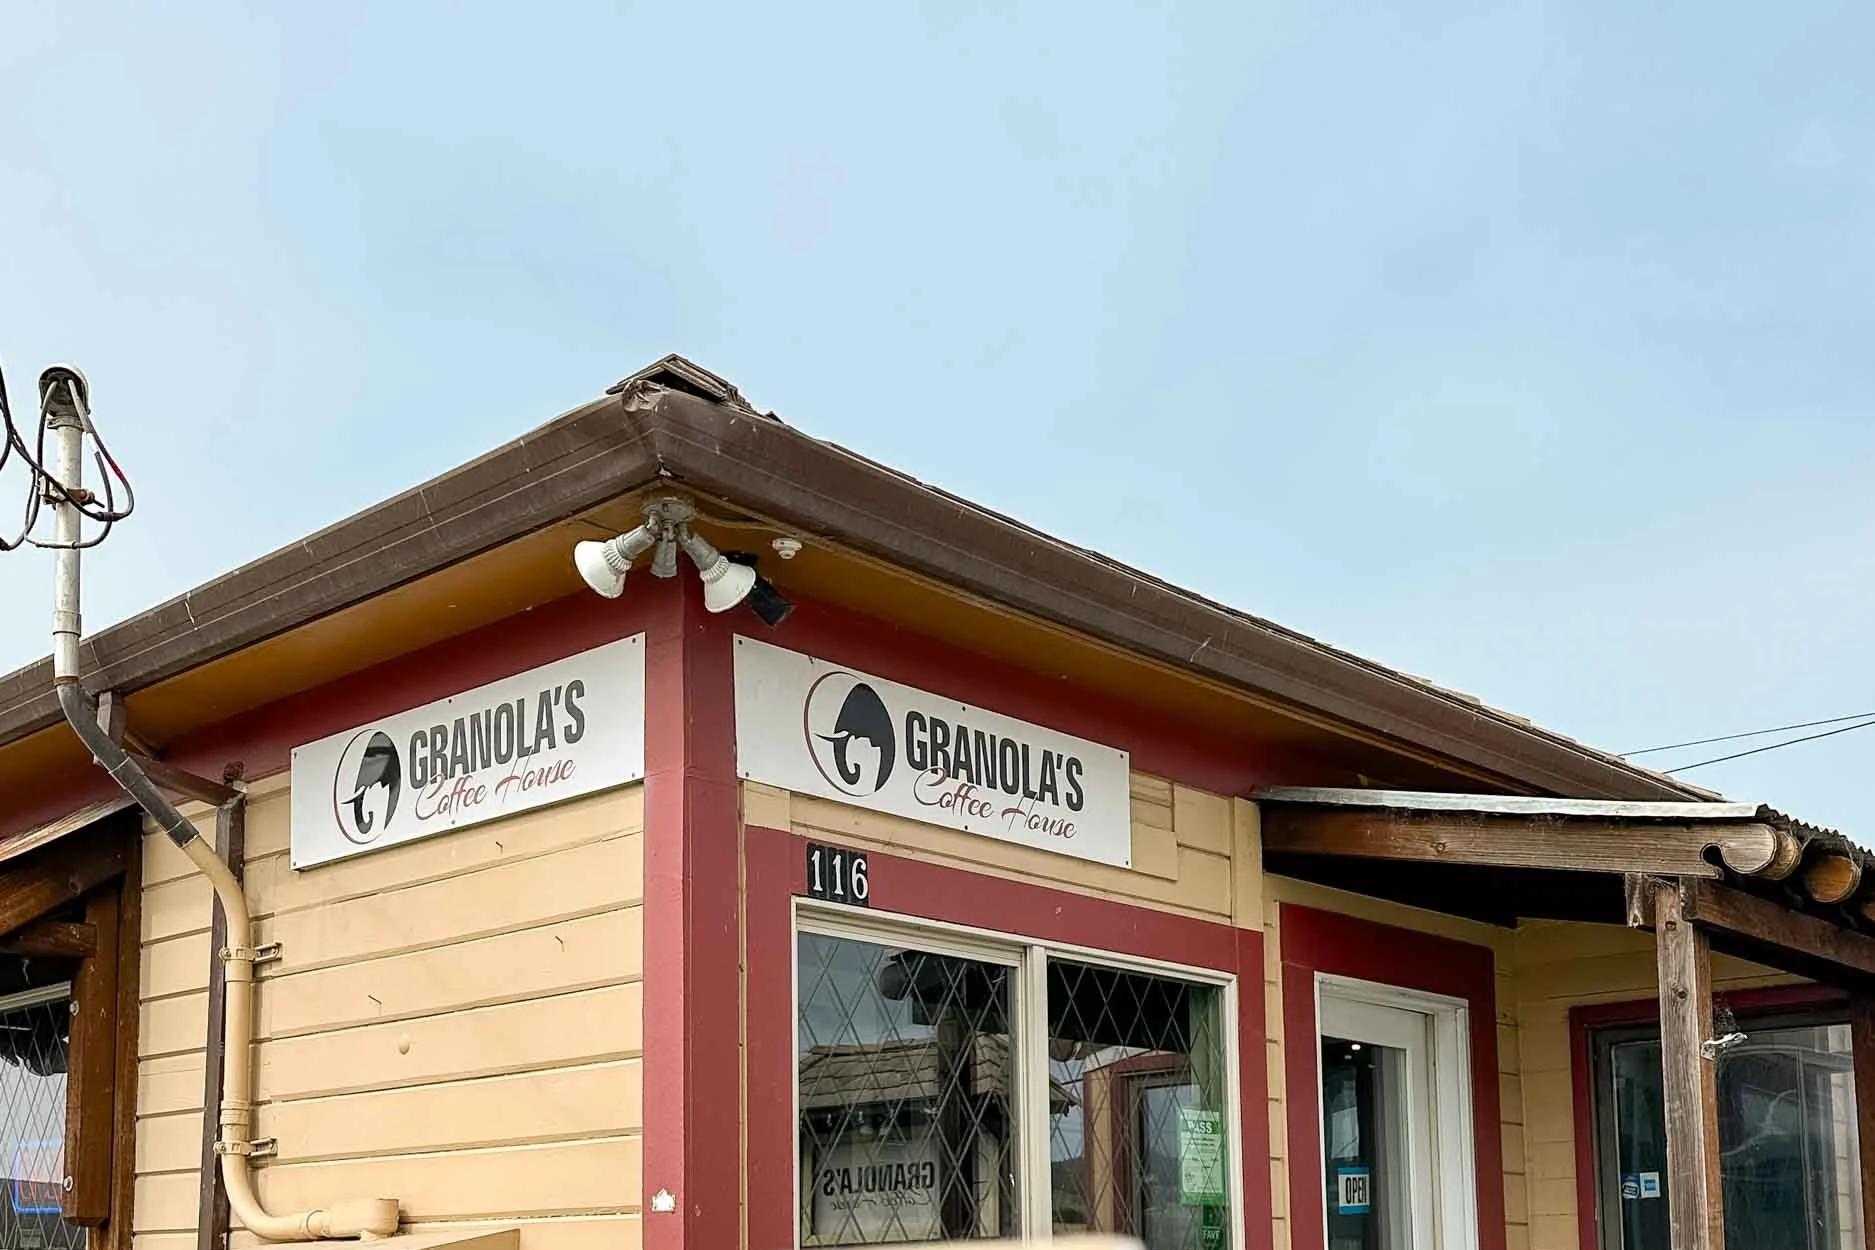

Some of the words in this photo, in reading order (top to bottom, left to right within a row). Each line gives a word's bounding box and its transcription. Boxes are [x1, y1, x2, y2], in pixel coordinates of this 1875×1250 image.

[409, 679, 585, 789] GRANOLA'S
[905, 710, 1084, 812] GRANOLA'S
[415, 773, 487, 820] Coffee
[495, 751, 576, 803] House
[913, 767, 994, 818] Coffee
[1001, 793, 1077, 838] House
[811, 850, 869, 900] 116
[1345, 1176, 1367, 1204] OPEN
